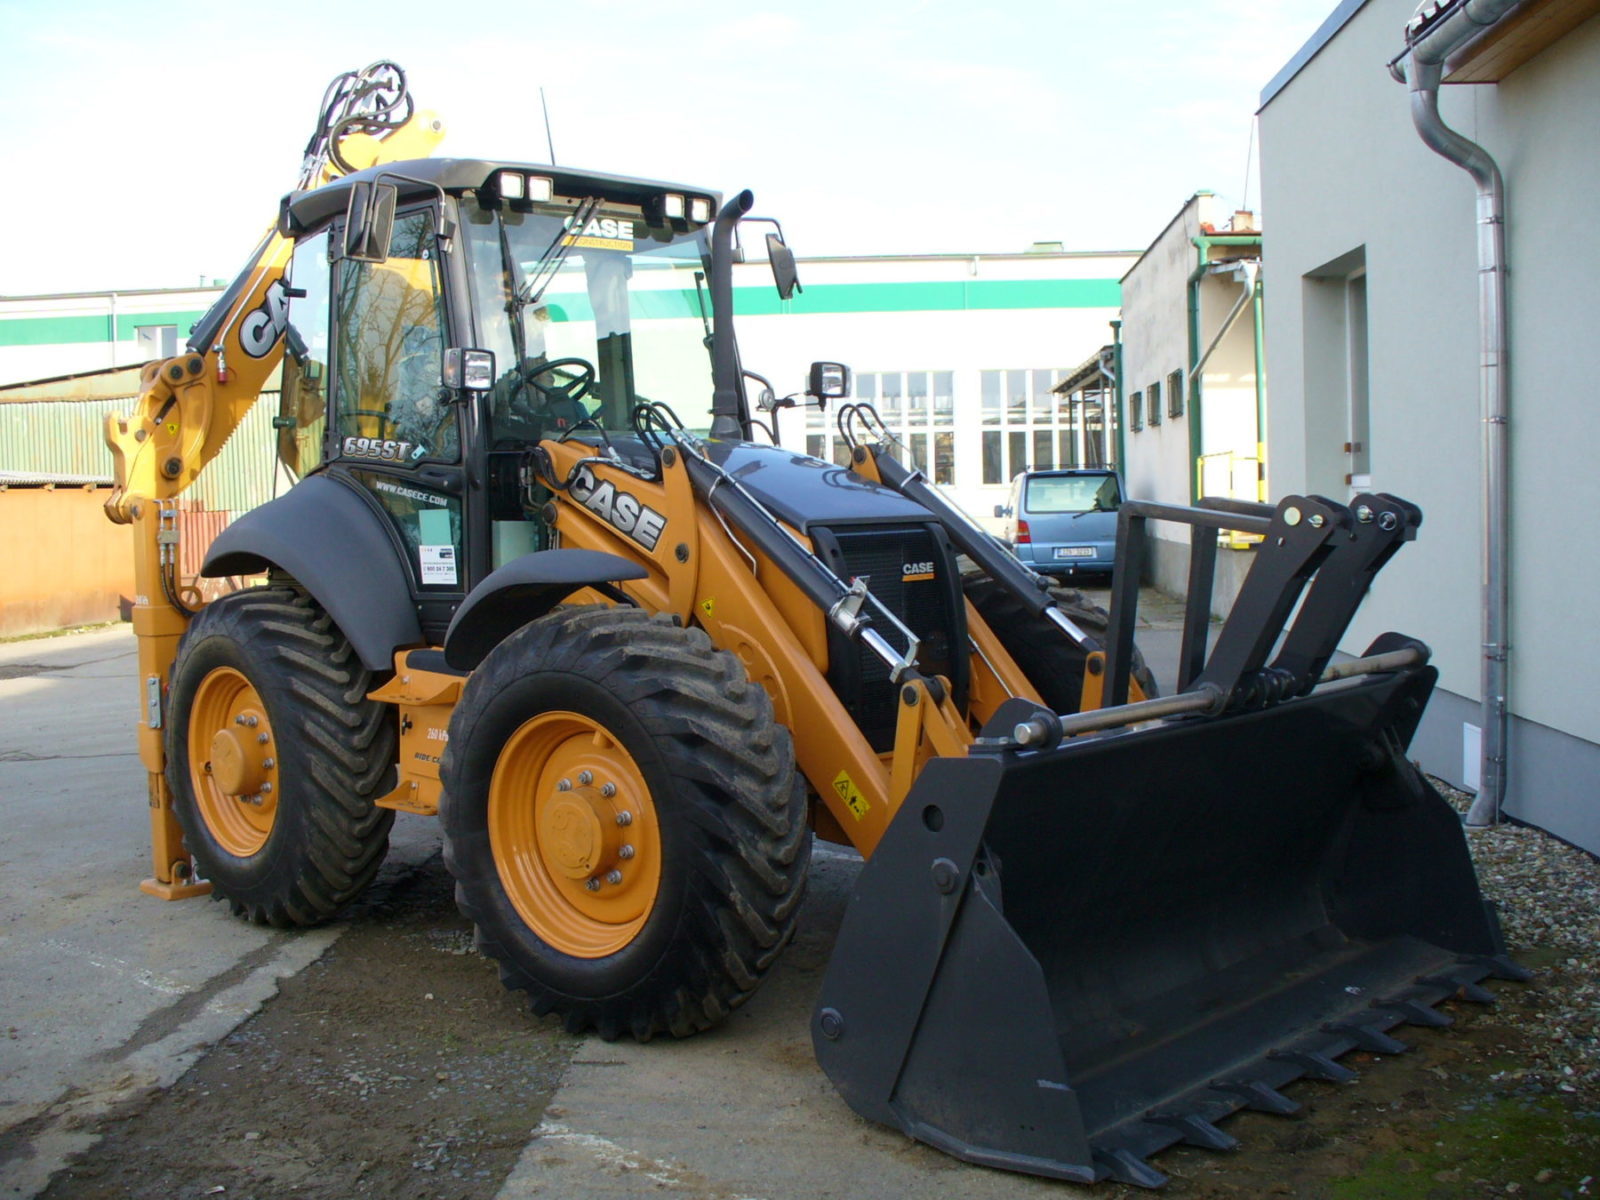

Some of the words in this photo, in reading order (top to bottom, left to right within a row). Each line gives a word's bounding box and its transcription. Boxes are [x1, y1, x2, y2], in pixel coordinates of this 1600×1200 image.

[564, 216, 634, 240] CASE
[343, 437, 411, 461] 695ST
[376, 482, 448, 507] WWW.CASECE.COM
[570, 467, 666, 550] CASE
[903, 562, 934, 574] CASE
